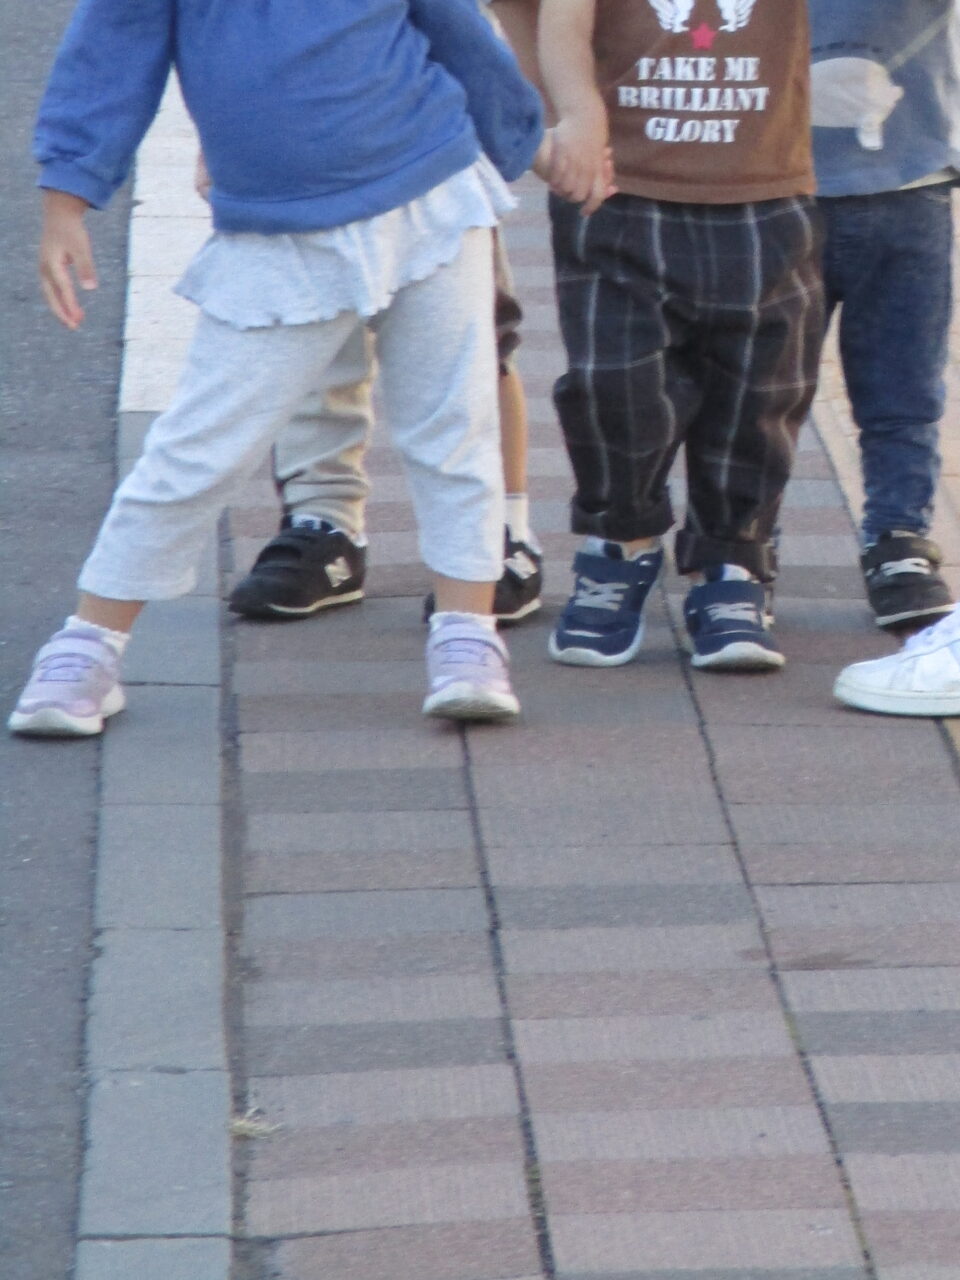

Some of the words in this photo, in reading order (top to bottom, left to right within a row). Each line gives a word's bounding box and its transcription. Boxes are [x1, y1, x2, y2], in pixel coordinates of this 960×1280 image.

[636, 56, 717, 82] TAKE
[722, 56, 761, 82] ME
[617, 86, 770, 112] BRILLIANT
[644, 116, 741, 143] GLORY
